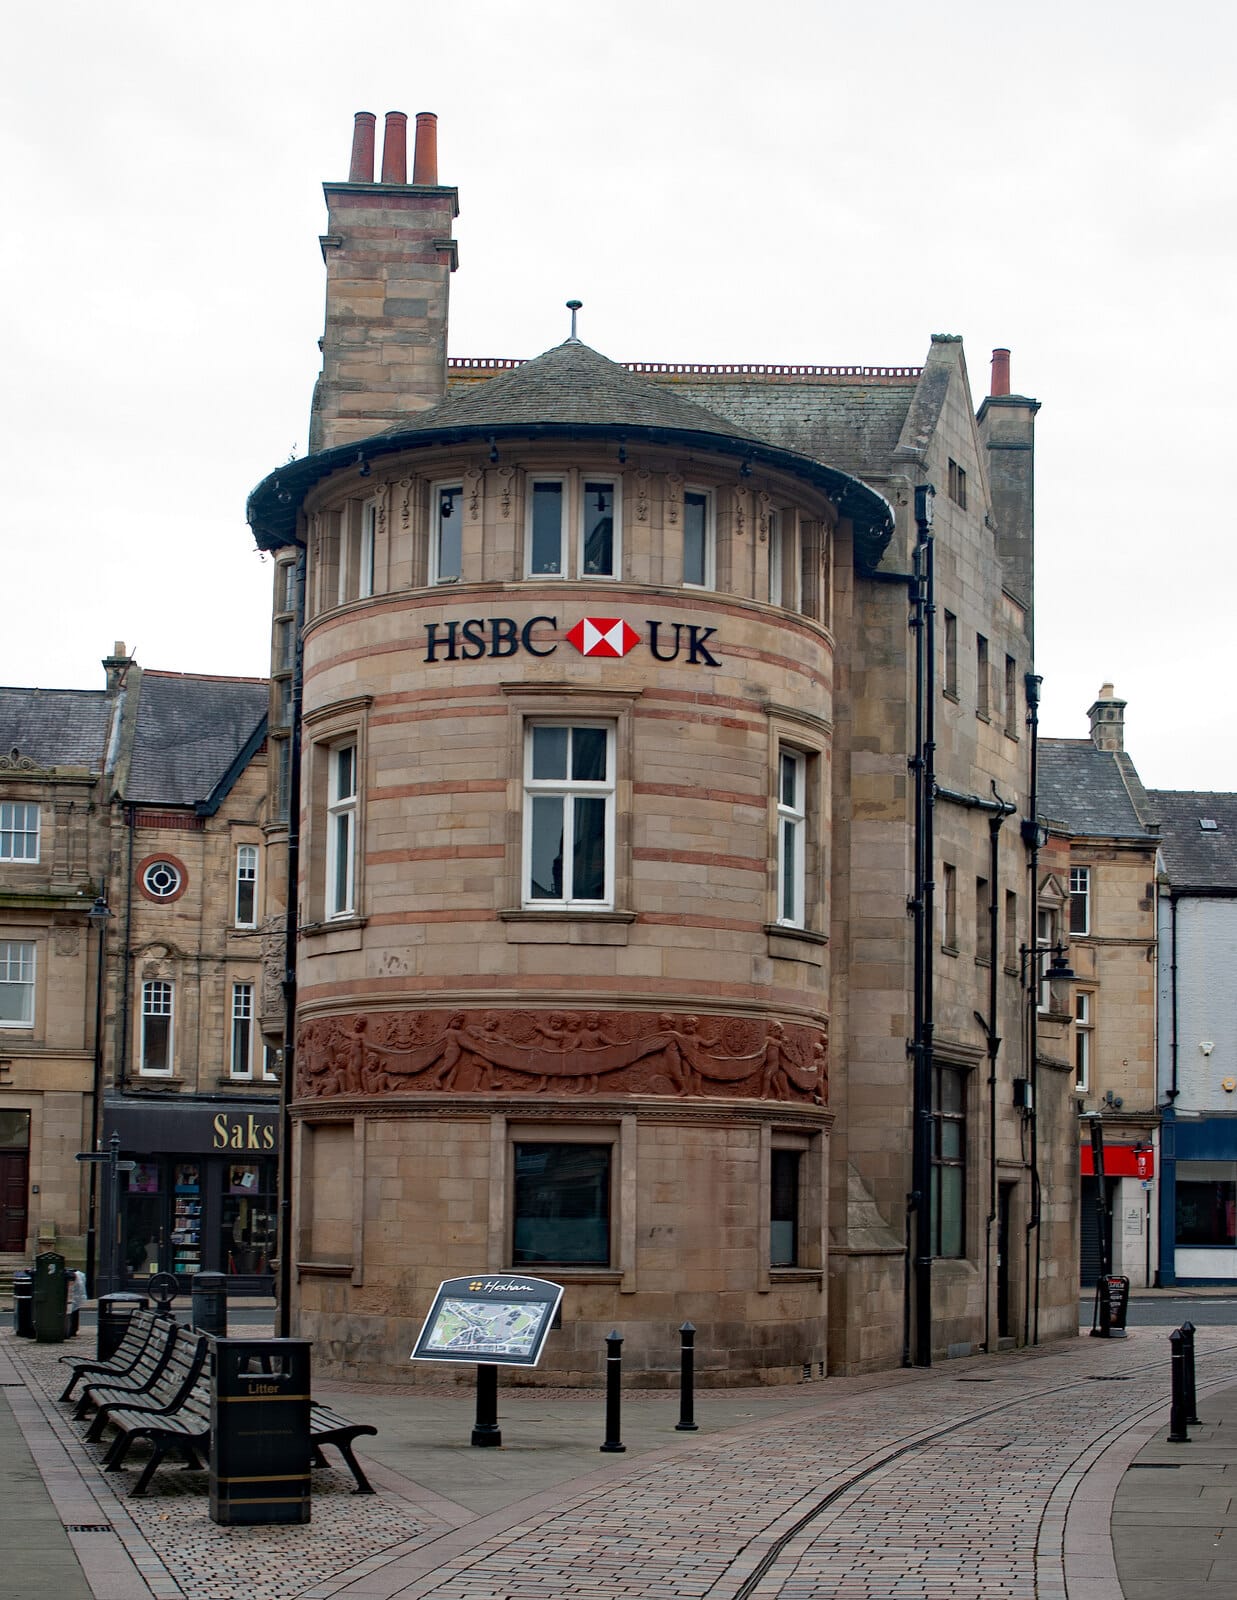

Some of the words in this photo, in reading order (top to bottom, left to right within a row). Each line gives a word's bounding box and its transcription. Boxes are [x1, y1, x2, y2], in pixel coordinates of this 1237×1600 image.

[423, 616, 558, 662] HSBC
[645, 620, 722, 667] UK
[213, 1113, 275, 1149] Saks
[483, 1279, 535, 1294] Hexham
[248, 1383, 280, 1394] Litter
